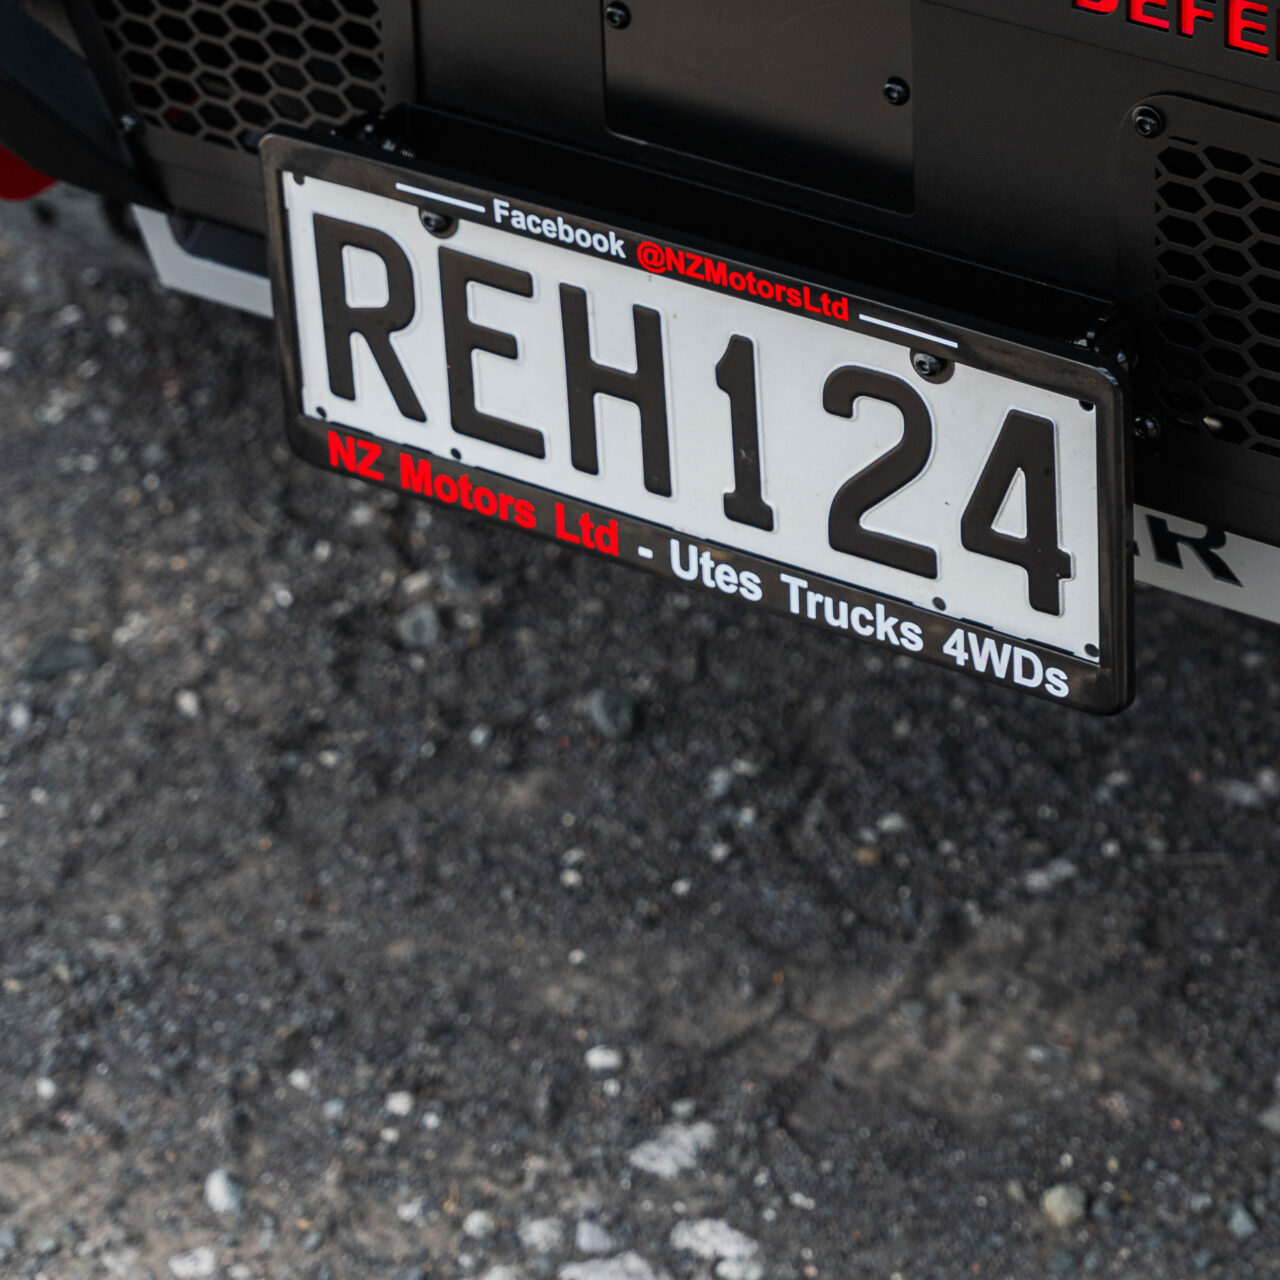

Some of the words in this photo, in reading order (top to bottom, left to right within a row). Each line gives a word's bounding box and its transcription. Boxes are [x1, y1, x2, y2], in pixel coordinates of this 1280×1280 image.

[492, 197, 627, 260] Facebook
[636, 240, 850, 322] @NZMotorsLtd
[312, 212, 1073, 618] REH124
[327, 429, 385, 482] NZ
[399, 452, 537, 530] Motors
[554, 501, 620, 557] Ltd
[669, 538, 764, 603] Utes
[778, 573, 925, 653] Trucks
[941, 628, 1071, 699] 4WDs
